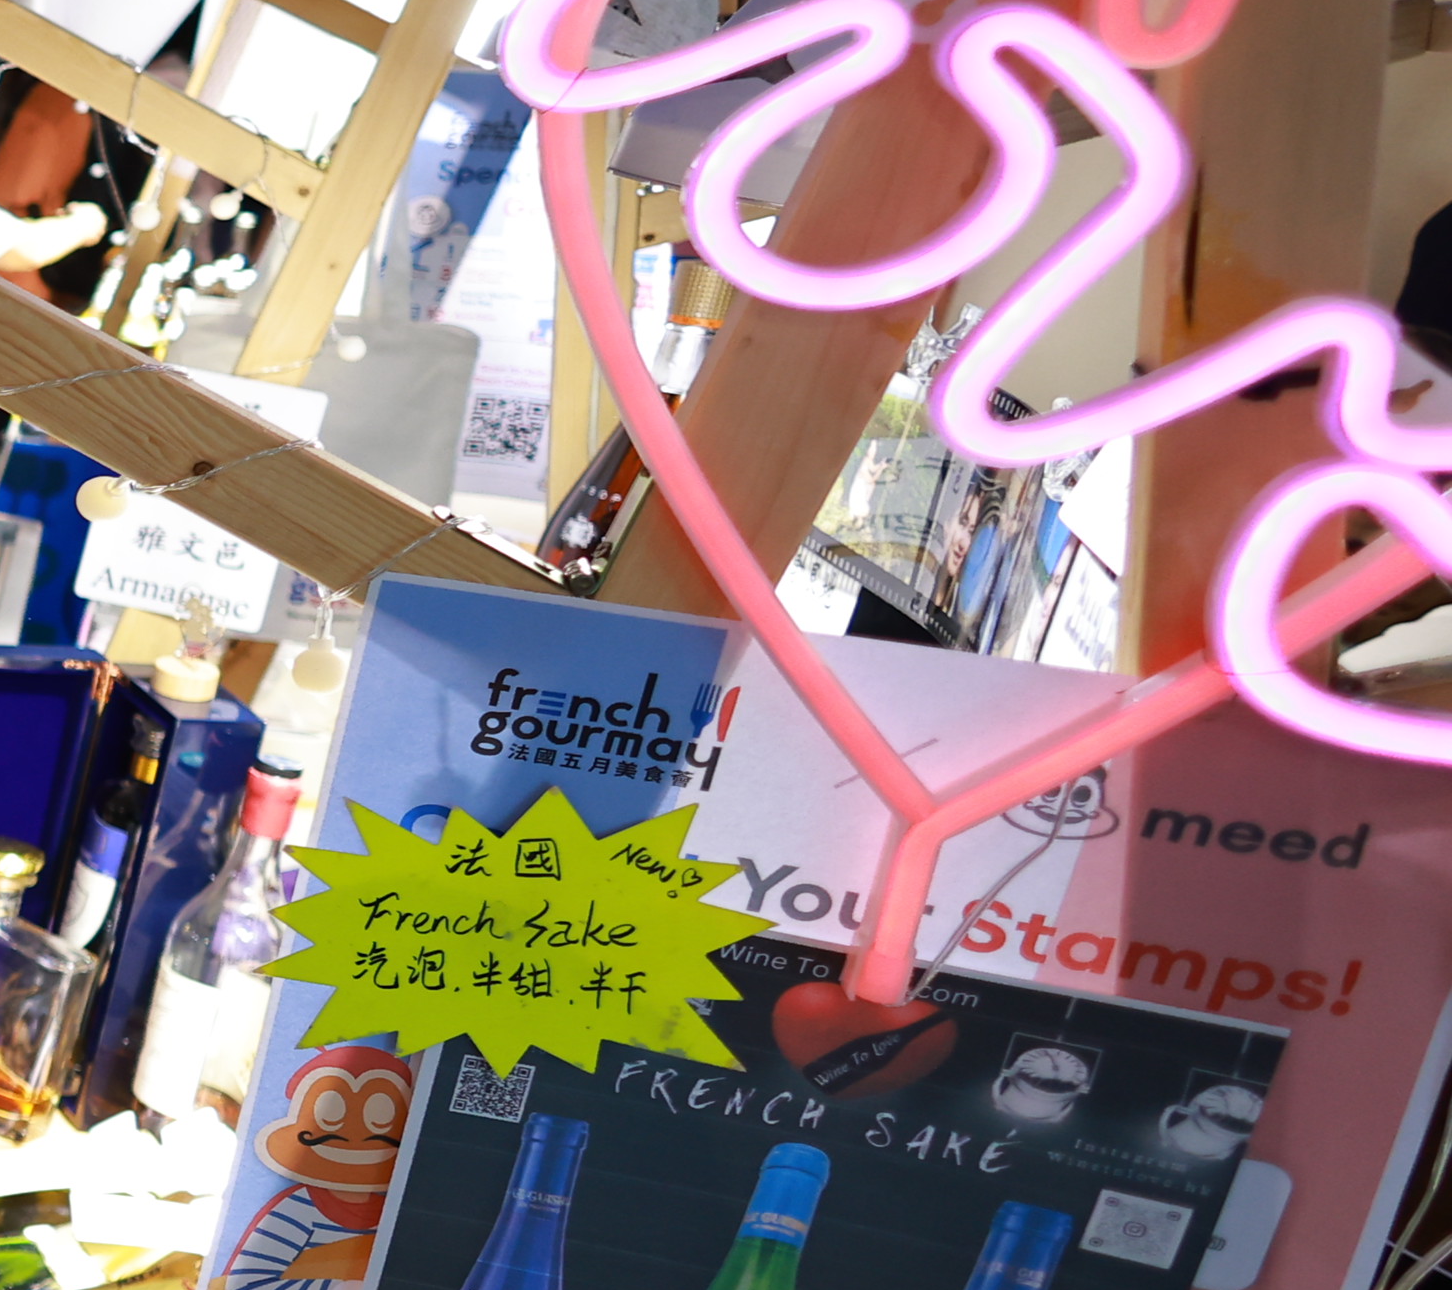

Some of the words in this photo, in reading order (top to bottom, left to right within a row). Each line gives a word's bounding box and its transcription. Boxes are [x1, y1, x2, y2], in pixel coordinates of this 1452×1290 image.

[132, 525, 246, 572] 雅文邑
[488, 668, 670, 733] french
[471, 711, 723, 791] gourmay
[508, 743, 694, 789] 法國五月美食薈
[445, 838, 560, 880] 法國
[1140, 807, 1371, 870] meed
[359, 892, 509, 941] French
[720, 943, 788, 971] Wine
[797, 956, 831, 978] To
[961, 900, 1363, 1016] Stamps!
[814, 1062, 850, 1088] Wine
[852, 1049, 871, 1067] To
[872, 1032, 904, 1058] Love
[614, 1060, 825, 1129] FRENCH
[864, 1112, 1023, 1174] SAKÉ
